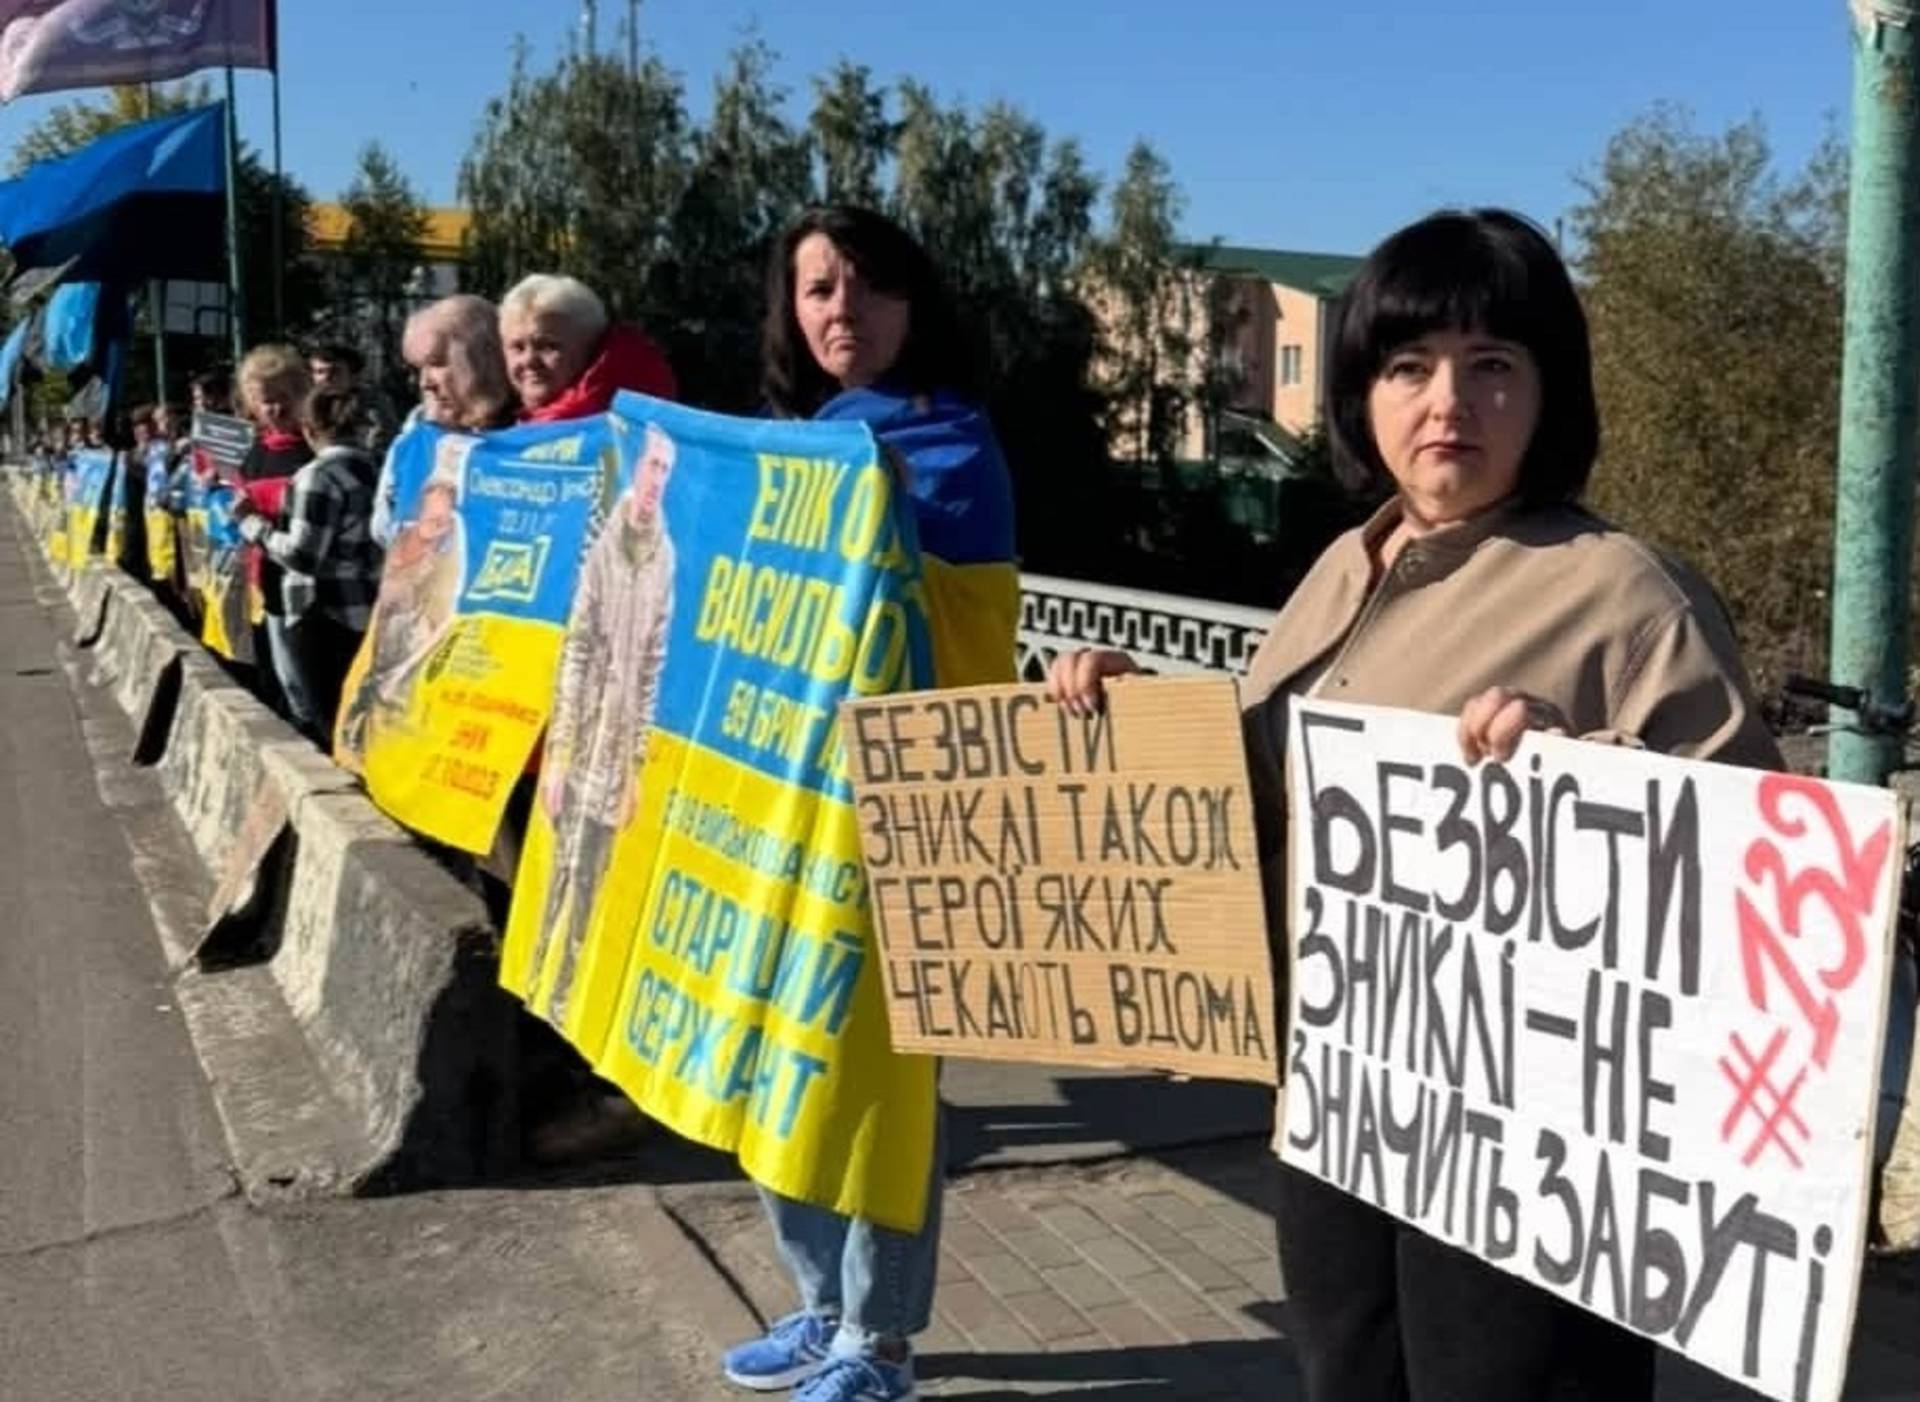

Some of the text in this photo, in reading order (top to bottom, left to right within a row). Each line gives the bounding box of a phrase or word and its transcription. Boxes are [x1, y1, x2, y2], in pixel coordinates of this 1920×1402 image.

[840, 464, 906, 568] О
[696, 554, 911, 694] ВАСИЛЬО
[854, 693, 1118, 784] БЕЗВІСТИ
[858, 783, 1240, 874] ЗНИКЛІ ТАКОЖ
[1299, 712, 1701, 996] БЕЗВІСТИ
[653, 869, 865, 1035] СТАРШИЙ
[872, 865, 1177, 955] ГЕРОЇ ЯКИХ
[629, 967, 828, 1138] СЕРЖАНТ
[889, 959, 1267, 1060] ЧЕКАЮТЬ ВДОМА
[1297, 886, 1516, 1110] ЗНИКЛІ
[1583, 968, 1675, 1162] НЕ
[1289, 1028, 1834, 1402] ЗНАЧИТЬ ЗАБУТІ
